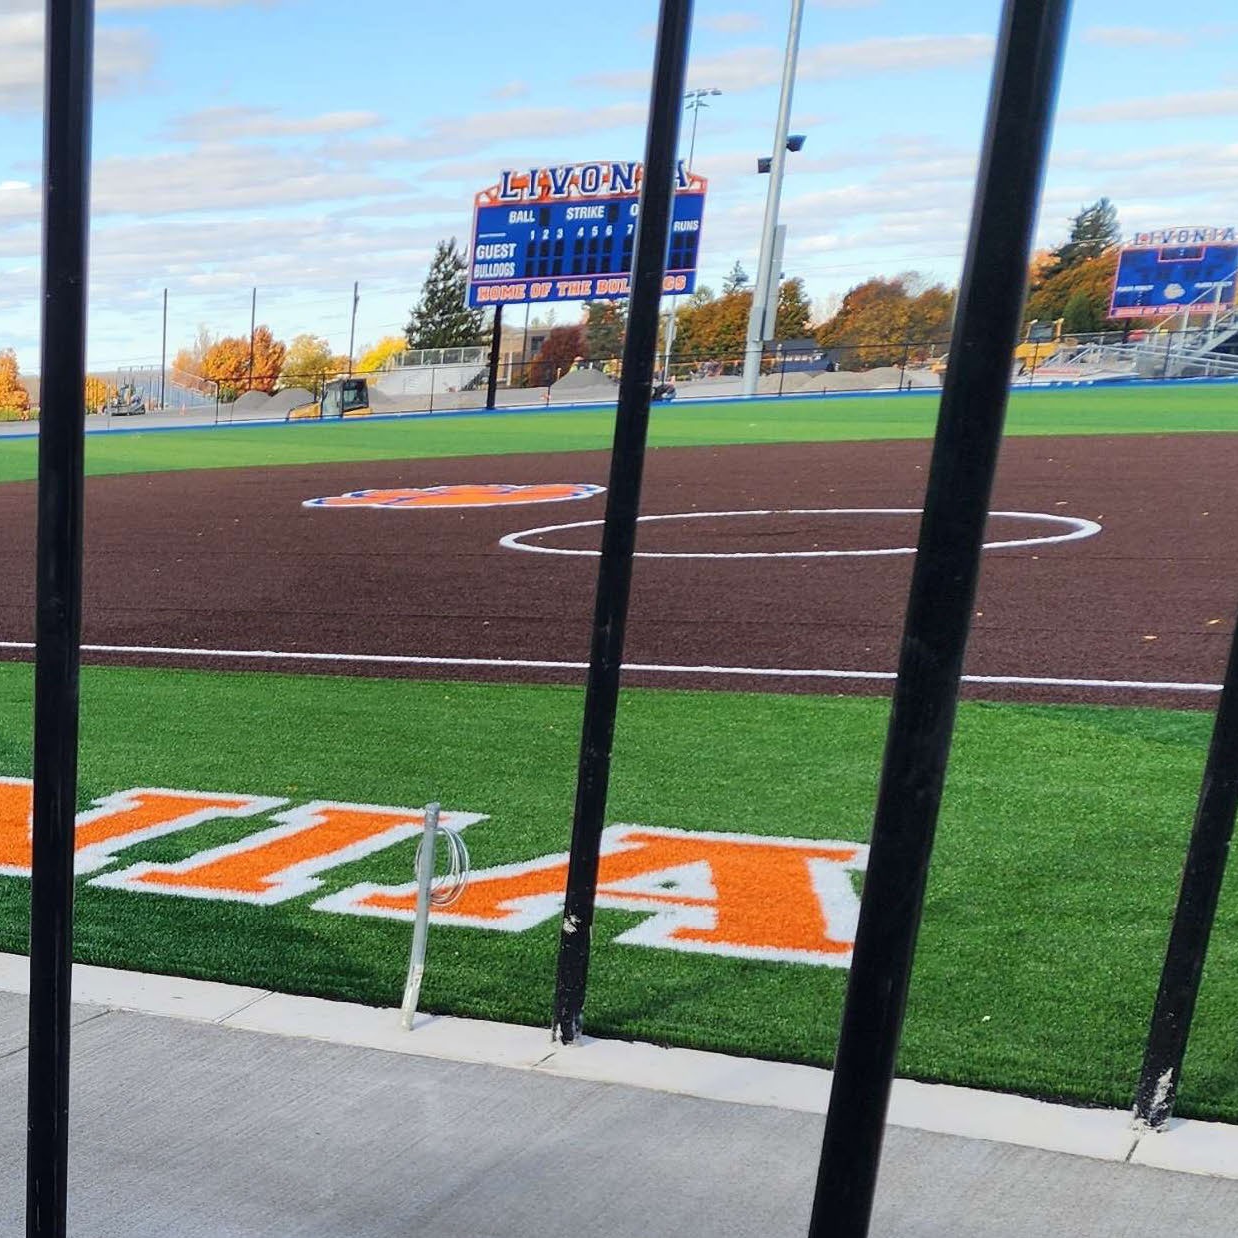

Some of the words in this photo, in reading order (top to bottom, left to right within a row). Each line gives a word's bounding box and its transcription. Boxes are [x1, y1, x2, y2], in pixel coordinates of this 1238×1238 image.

[499, 159, 689, 200] LIVONA
[509, 209, 535, 224] BALL
[566, 205, 605, 220] STRIKE
[530, 229, 536, 241] 1
[542, 228, 550, 240] 2
[556, 227, 564, 240] 3
[577, 226, 585, 238] 4
[591, 225, 599, 237] 5
[605, 224, 613, 236] 6
[627, 223, 634, 235] 7
[673, 220, 699, 232] RUNS
[1134, 227, 1235, 246] LIVONIA
[476, 243, 517, 259] GUEST
[474, 262, 516, 278] BULLDOGS
[477, 284, 527, 302] HOME
[530, 282, 553, 299] OF
[557, 280, 592, 298] THE
[596, 275, 687, 295] BULGS
